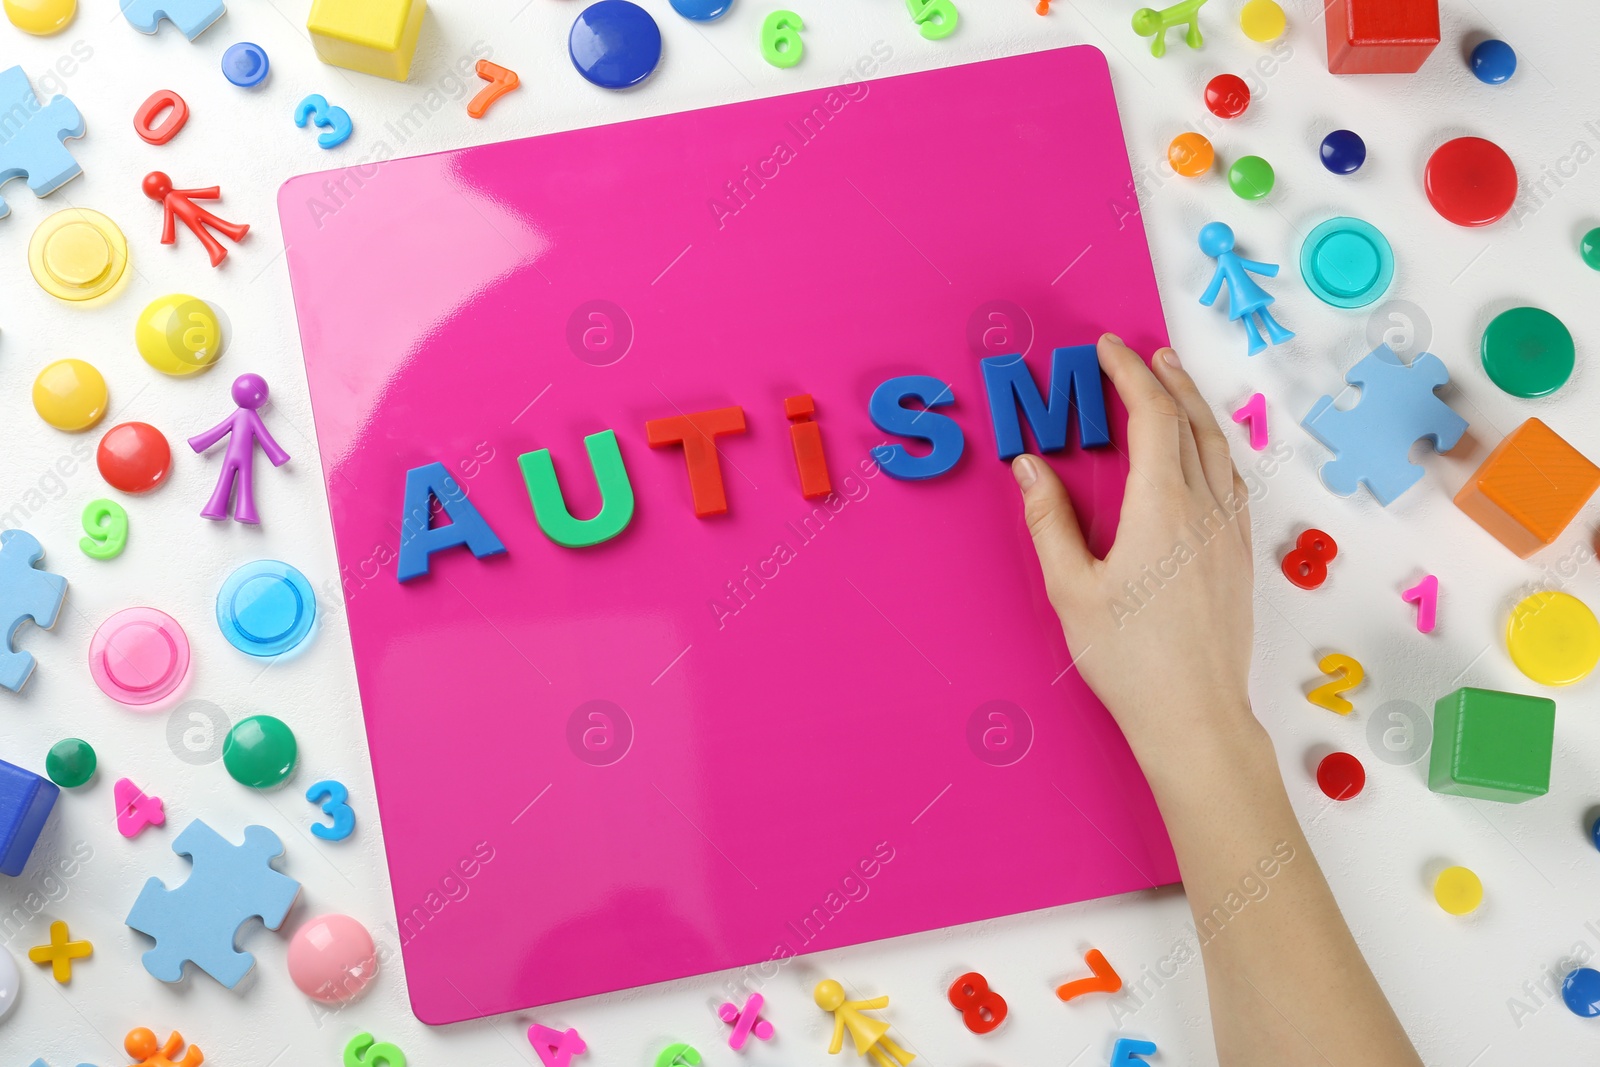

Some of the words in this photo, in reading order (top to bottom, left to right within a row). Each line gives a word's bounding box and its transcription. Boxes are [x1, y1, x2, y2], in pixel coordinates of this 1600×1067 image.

[759, 10, 806, 68] 6
[468, 60, 520, 119] 7
[294, 94, 353, 149] 3
[1233, 394, 1268, 450] 1
[79, 499, 128, 560] 9
[1281, 529, 1338, 590] 8
[1402, 575, 1438, 633] 1
[1307, 653, 1365, 716] 2
[114, 779, 165, 838] 4
[306, 780, 355, 841] 3
[948, 972, 1008, 1034] 8
[1056, 949, 1122, 1002] 7
